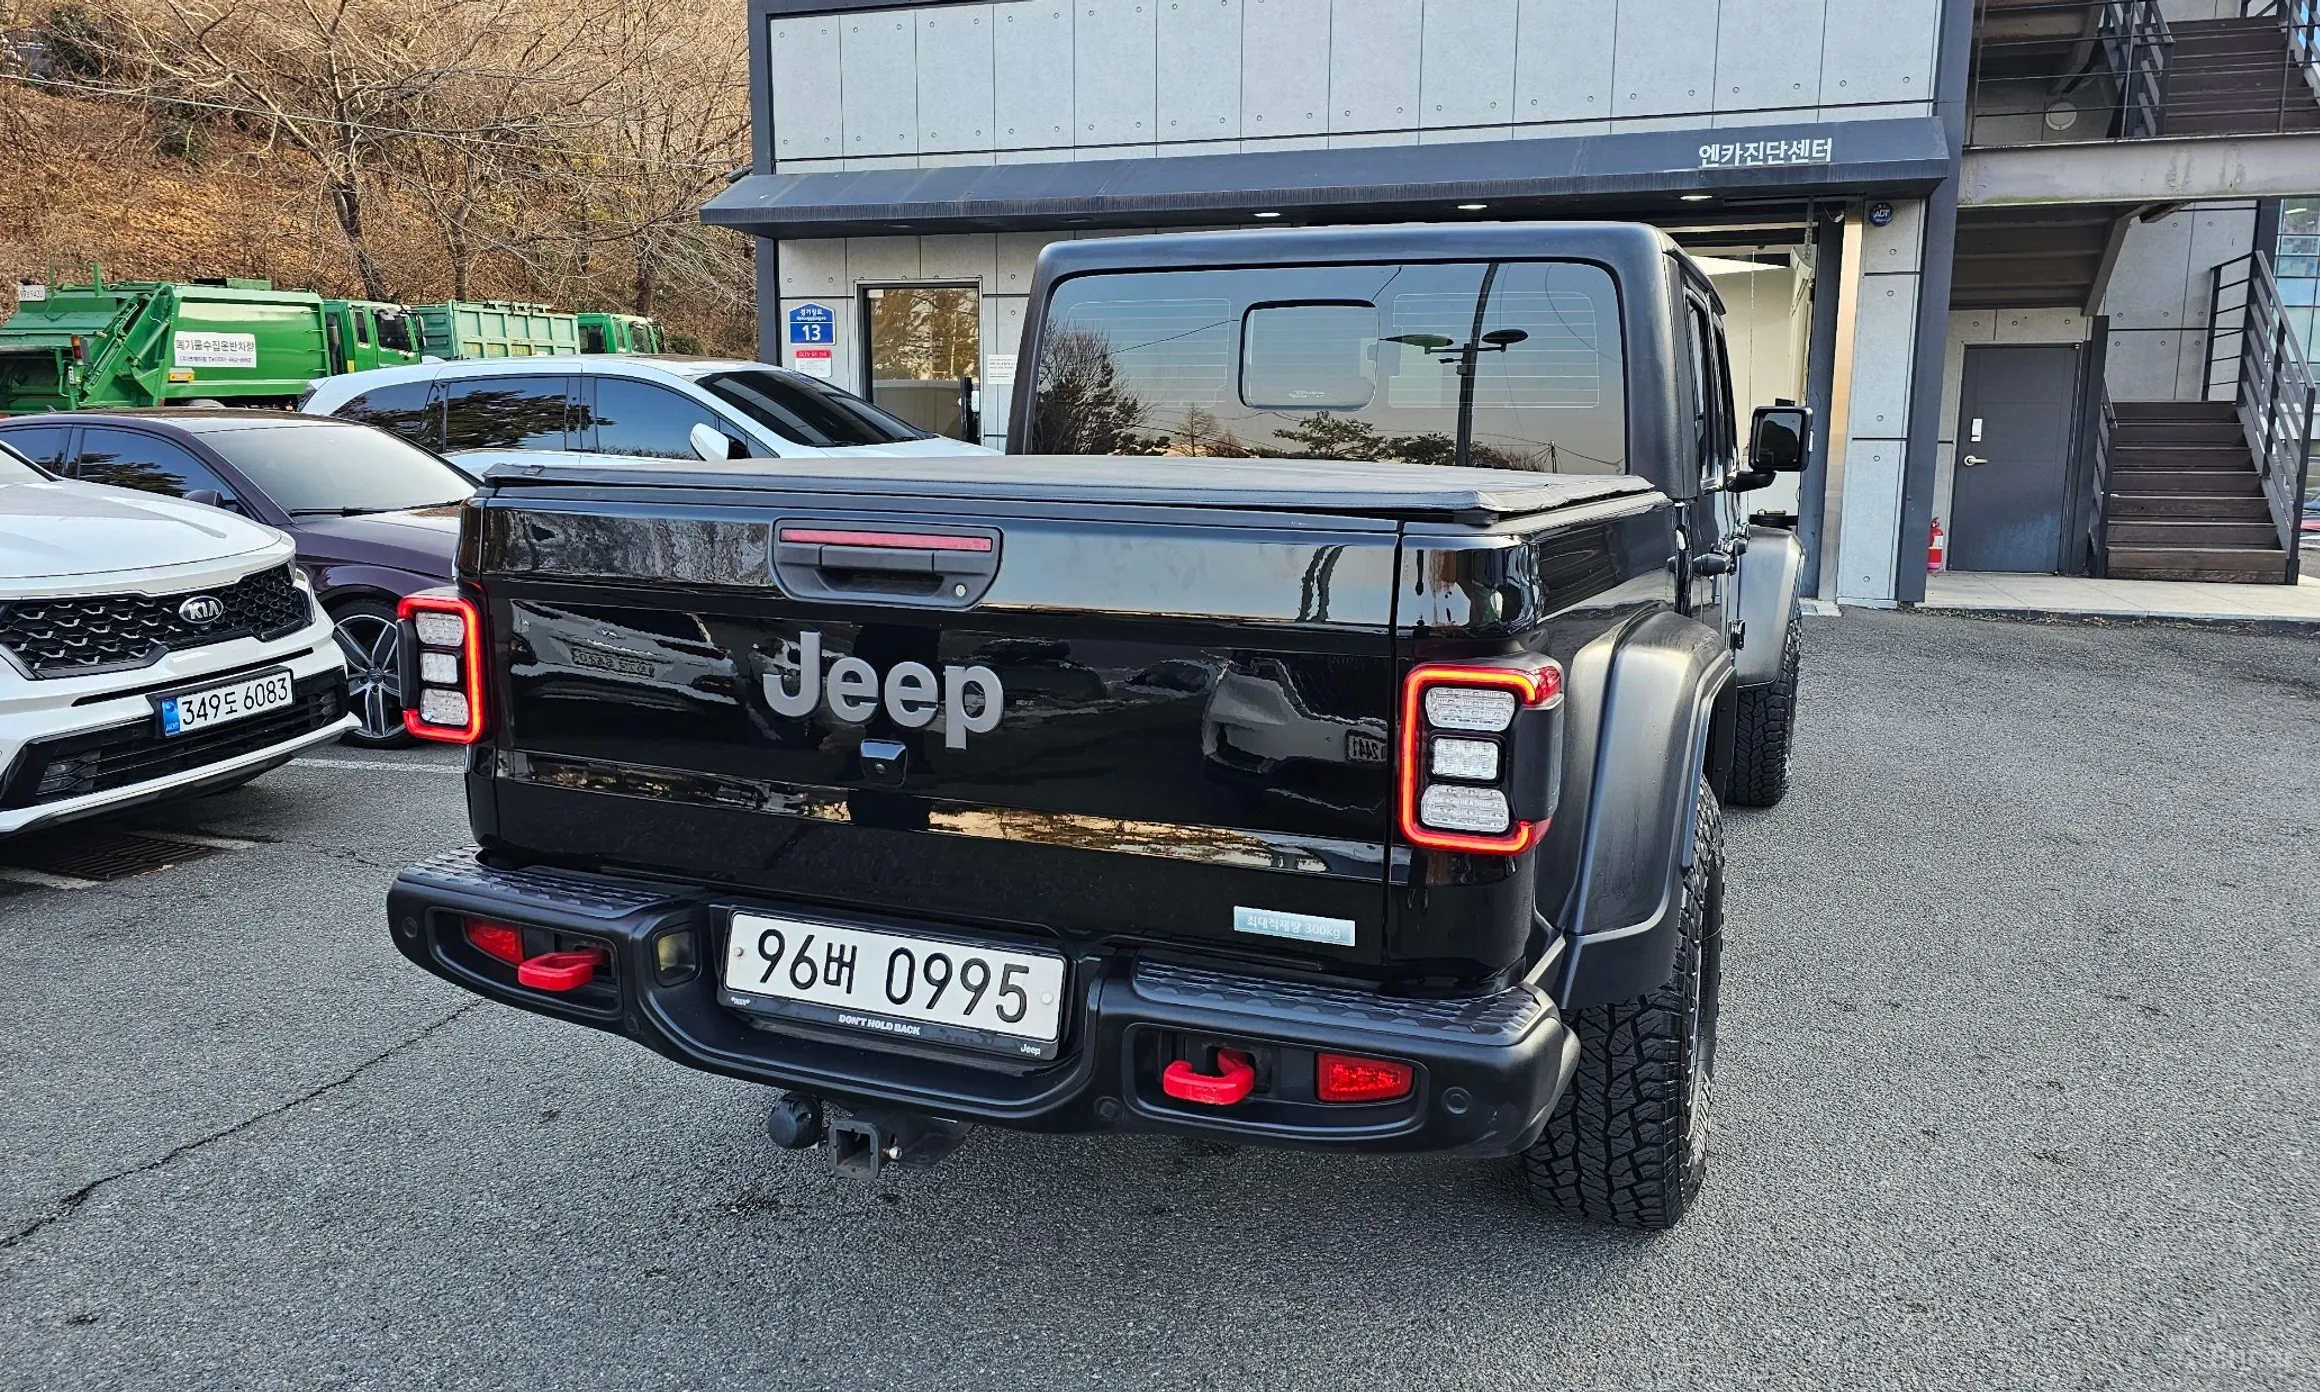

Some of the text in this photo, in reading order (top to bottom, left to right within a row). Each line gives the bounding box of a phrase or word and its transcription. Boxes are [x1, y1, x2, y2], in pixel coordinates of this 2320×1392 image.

[1698, 138, 1833, 168] 엔카진단센터
[802, 324, 821, 341] 13
[188, 600, 219, 620] KIA
[182, 677, 288, 725] 349도 6083
[763, 631, 1004, 750] Jeep
[1247, 915, 1340, 939] 최대적재량 300kg
[757, 928, 1029, 1024] 96버 0995
[839, 1014, 921, 1036] DON'T HOLD BACK
[1020, 1043, 1041, 1057] Jeep
